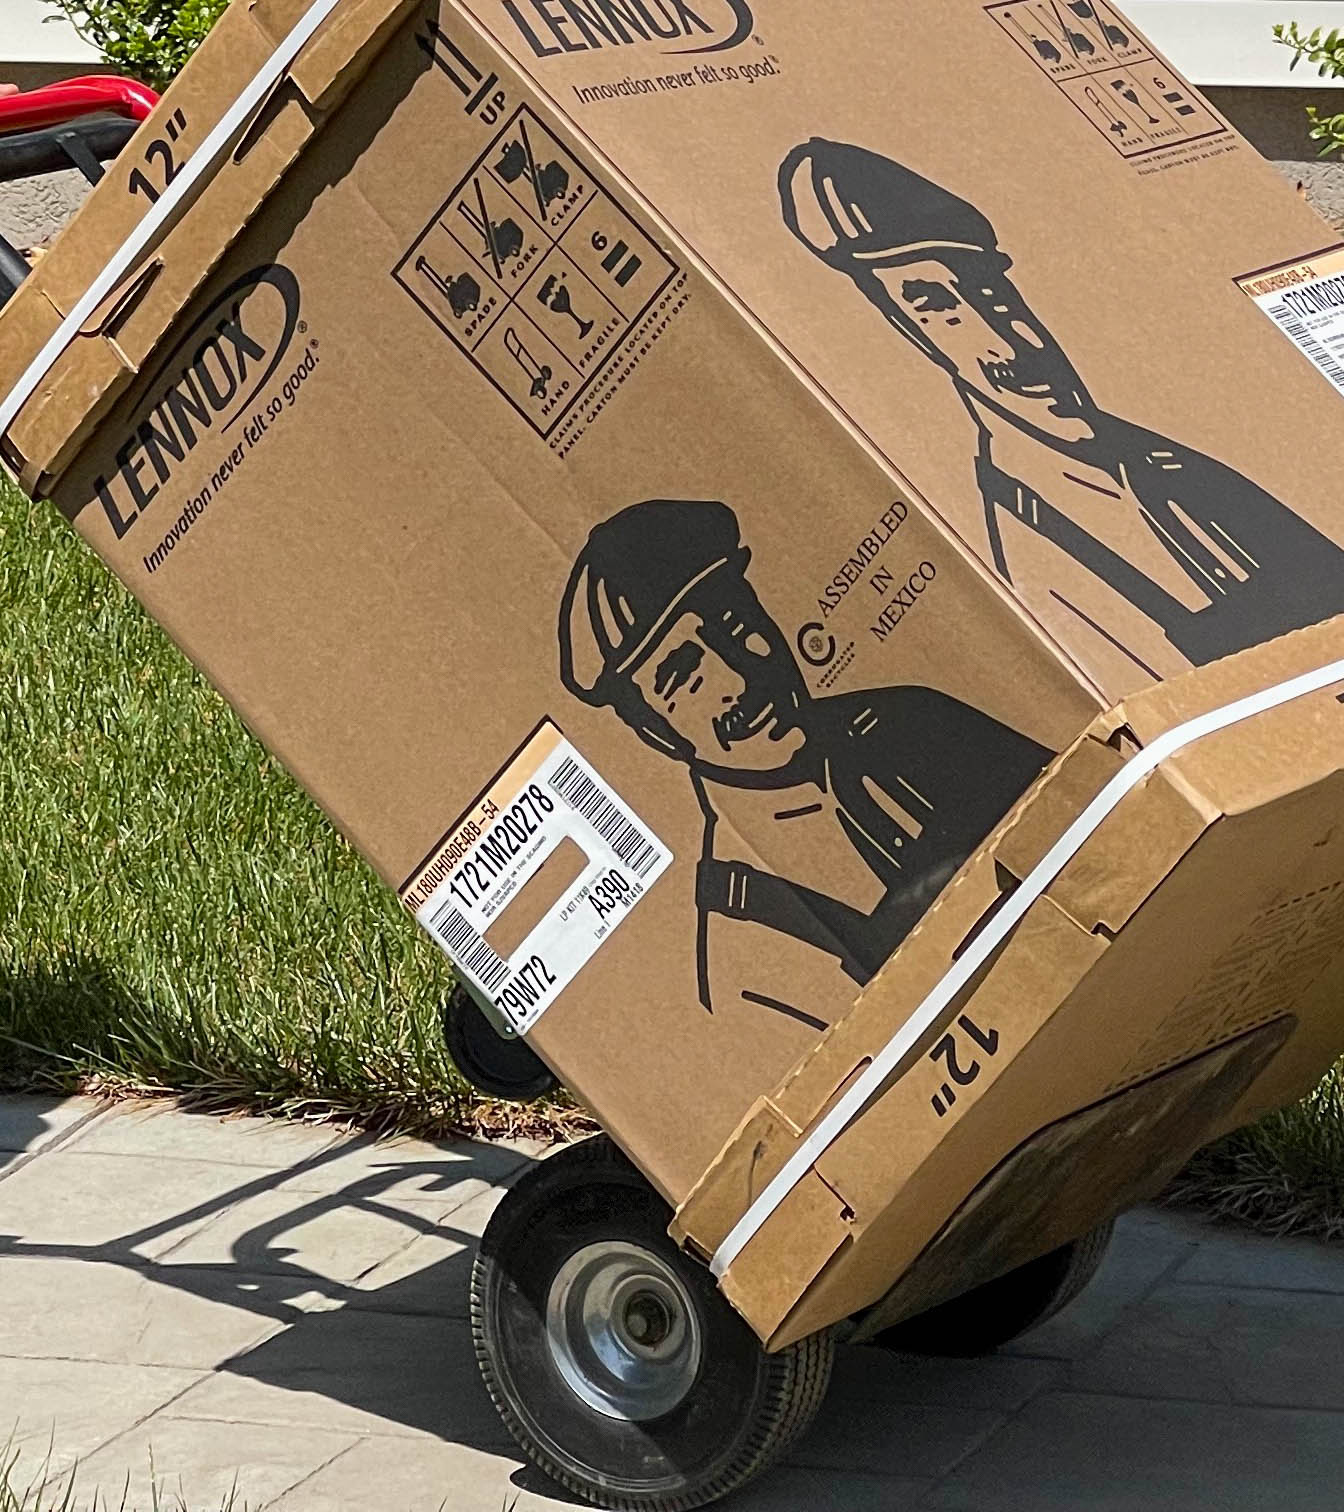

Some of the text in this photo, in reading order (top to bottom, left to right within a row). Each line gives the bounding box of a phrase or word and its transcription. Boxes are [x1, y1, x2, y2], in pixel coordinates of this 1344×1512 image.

[479, 90, 507, 126] UP
[572, 76, 657, 104] Innovation
[656, 70, 695, 90] never
[694, 64, 721, 85] felt
[721, 65, 739, 81] so
[1153, 77, 1167, 90] 6
[129, 107, 188, 205] 12"
[550, 184, 586, 227] CLAMP
[510, 243, 540, 279] FORK
[591, 230, 608, 251] 6
[464, 296, 498, 337] SPADE
[625, 311, 658, 354] LOCATED
[659, 294, 673, 310] ON
[671, 272, 688, 293] TOP
[578, 316, 621, 369] FRAGILE
[586, 386, 618, 424] CARTON
[617, 355, 641, 385] MUST
[640, 342, 652, 356] BE
[651, 316, 672, 341] KEPT
[93, 301, 266, 540] LENNOX
[541, 380, 571, 417] HAND
[143, 486, 212, 574] Innovation
[211, 442, 245, 492] never
[243, 413, 269, 448] felt
[266, 397, 283, 422] so
[817, 501, 908, 618] ASSEMBLED
[869, 564, 895, 596] IN
[869, 561, 937, 643] MEXICO
[450, 783, 555, 909] 1721M20278
[587, 869, 630, 919] A390
[494, 955, 556, 1026] 79W72
[929, 1014, 999, 1118] 12"
